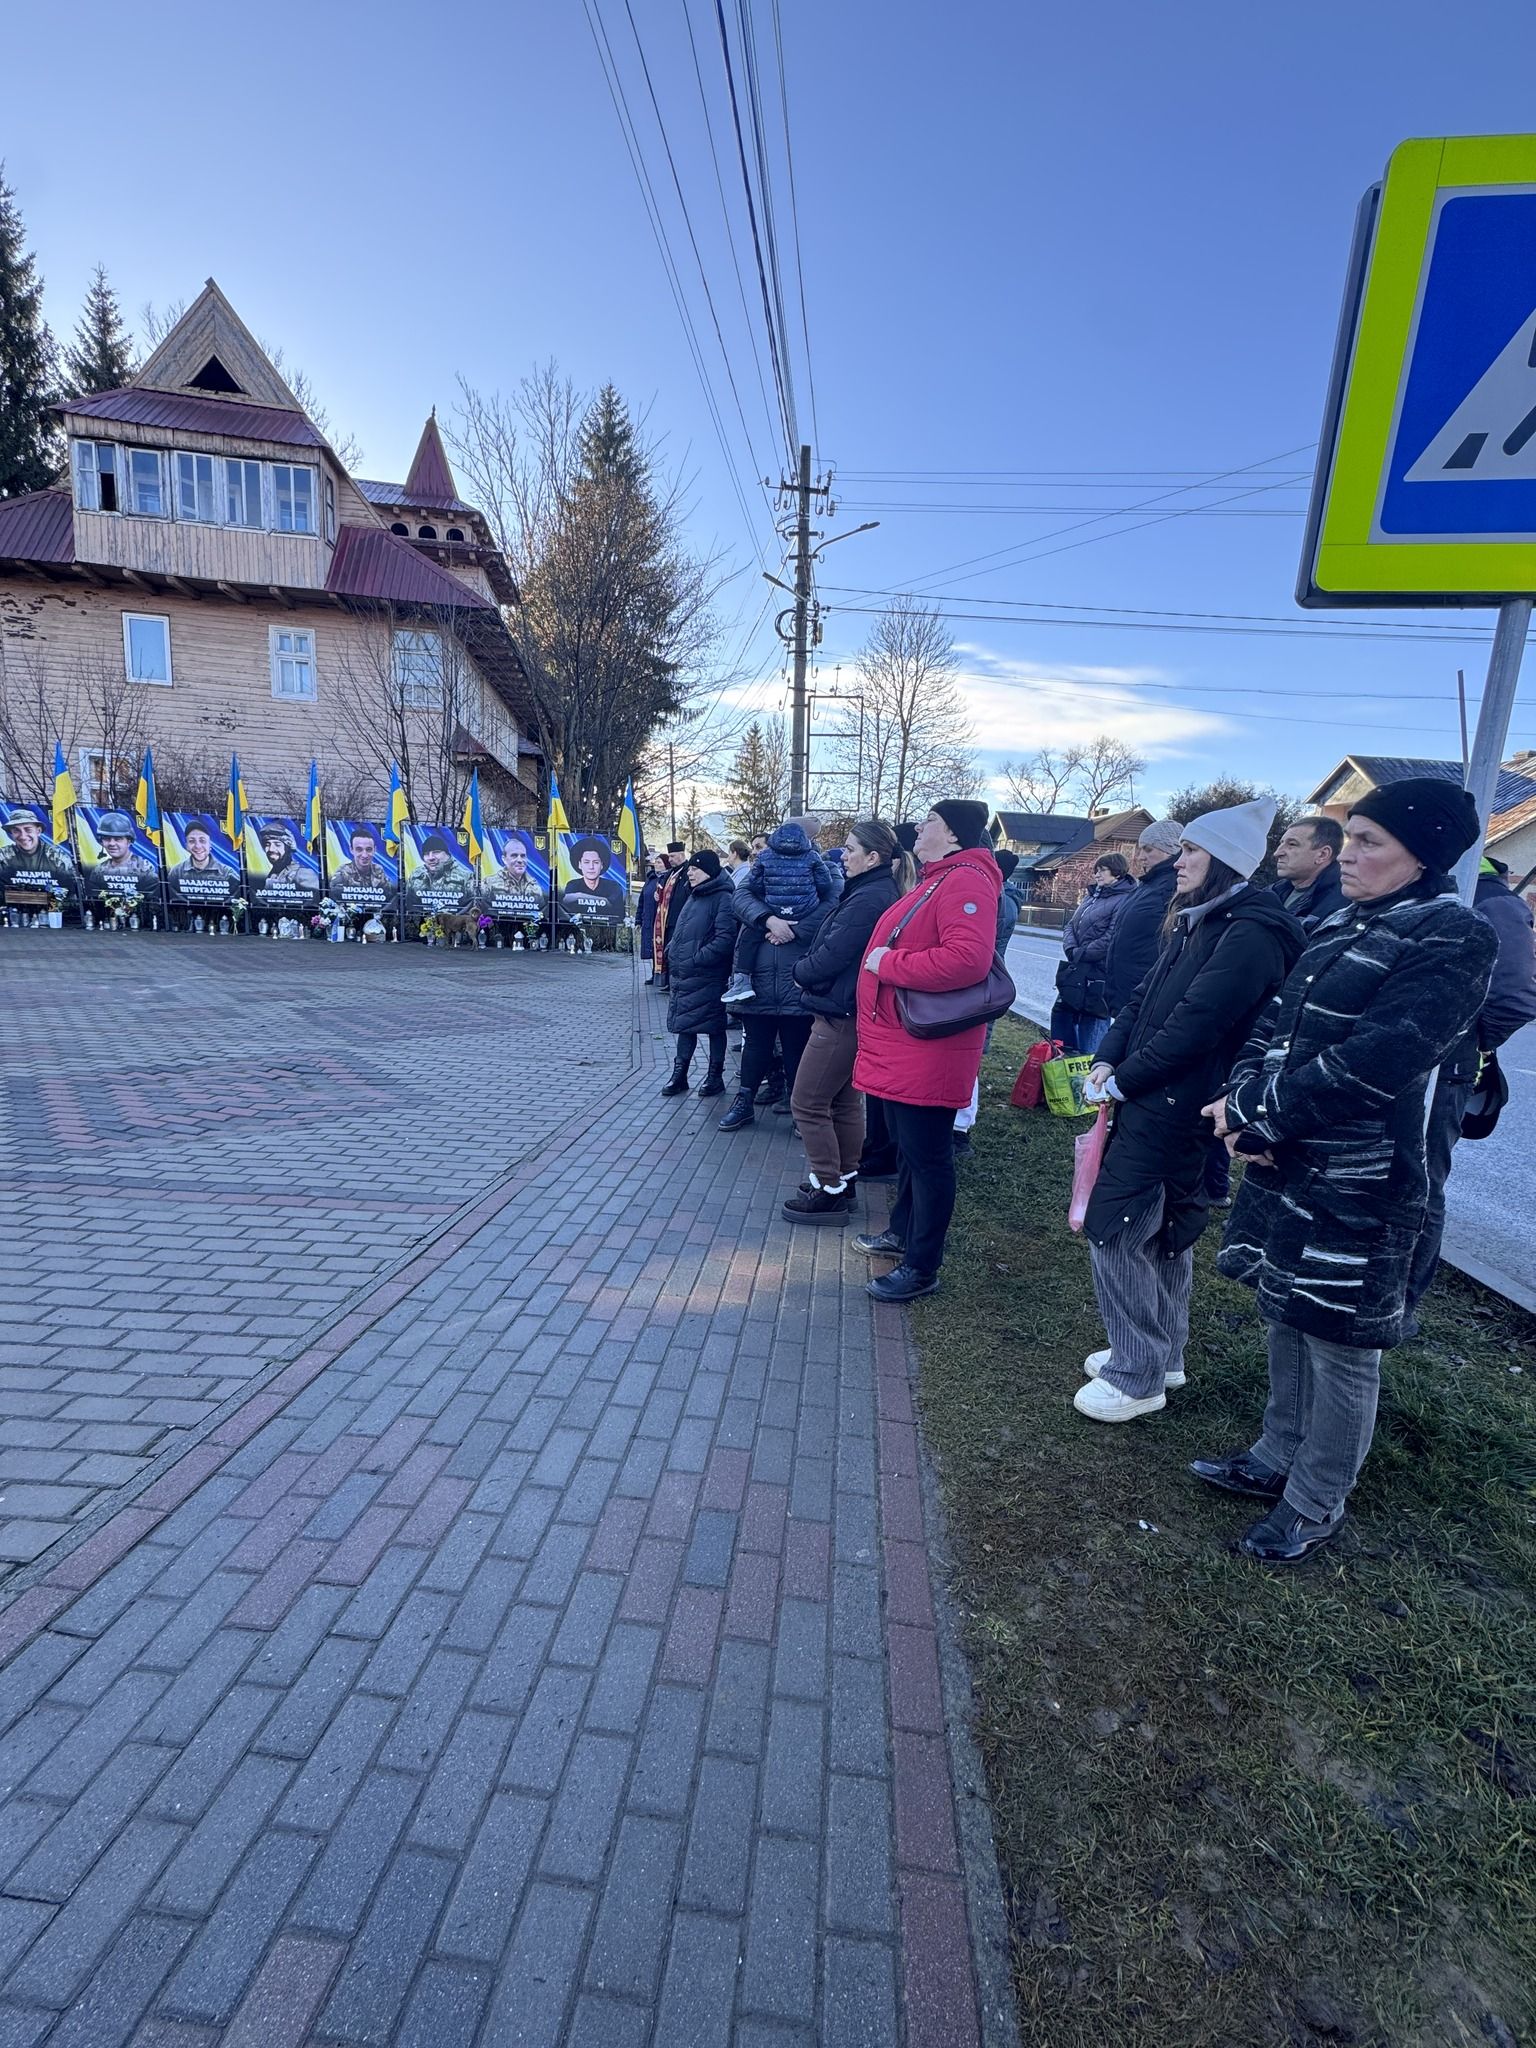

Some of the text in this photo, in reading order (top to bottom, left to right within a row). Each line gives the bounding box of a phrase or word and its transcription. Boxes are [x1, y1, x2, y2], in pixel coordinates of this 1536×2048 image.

[179, 879, 230, 887] ВЛАДИСЛАВ
[180, 886, 230, 894] ШУРГАЛЮК
[256, 889, 313, 898] ДОБРОЦЬКИЙ
[343, 886, 384, 894] МИХАЙЛО
[415, 890, 464, 899] ОЛЕКСАНДР
[341, 893, 387, 902] ПЕТРОЧКО
[421, 897, 460, 906] ПРОСТАК
[495, 894, 535, 903] МИХАЙЛО
[577, 898, 607, 907] ПАВЛО
